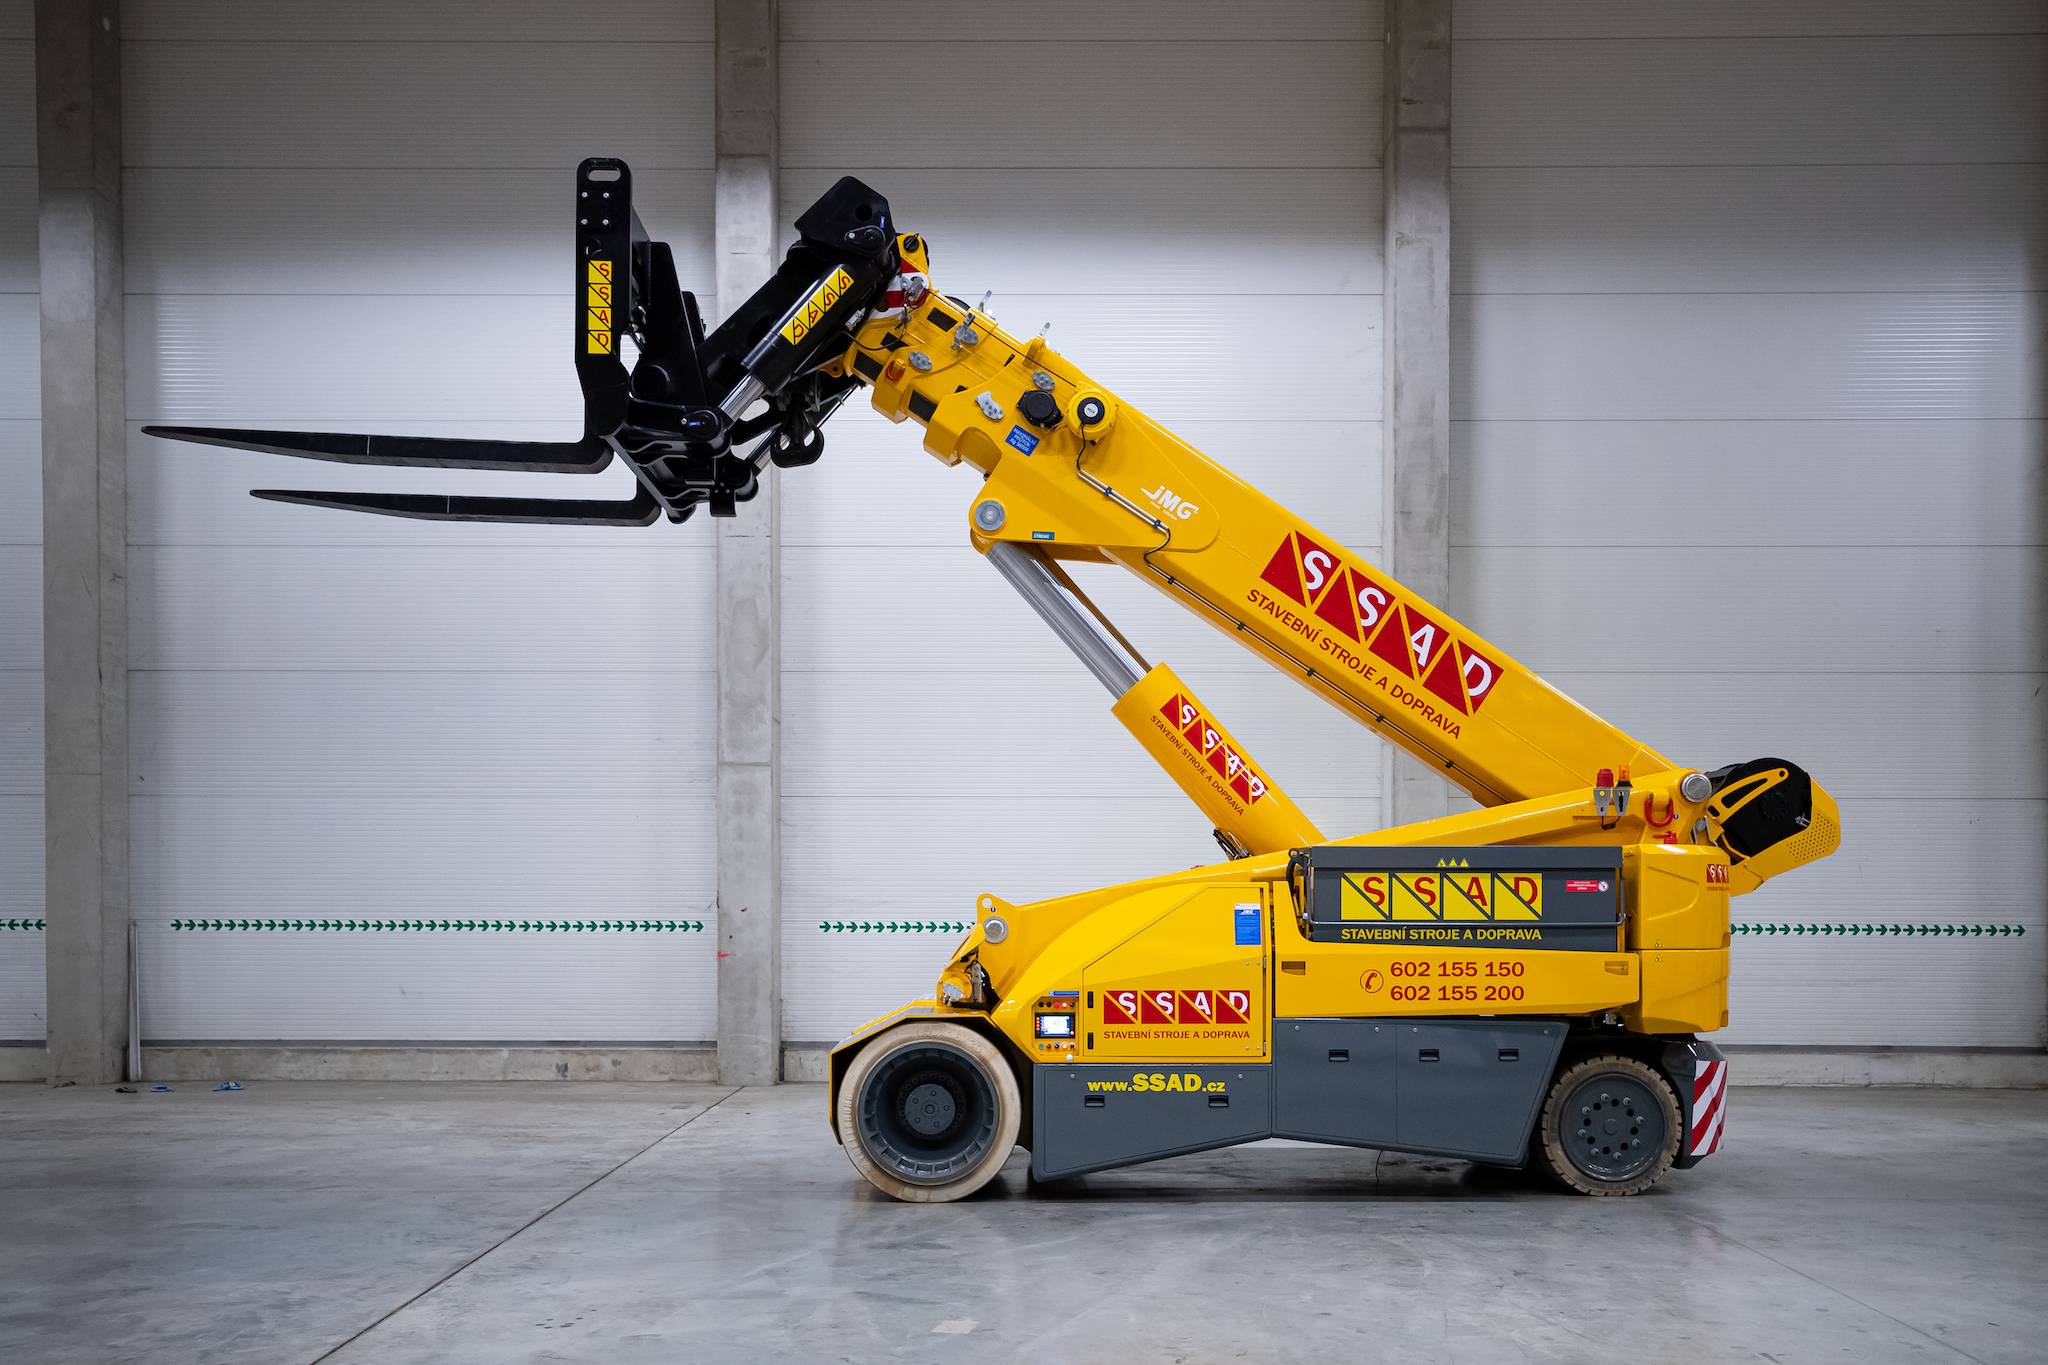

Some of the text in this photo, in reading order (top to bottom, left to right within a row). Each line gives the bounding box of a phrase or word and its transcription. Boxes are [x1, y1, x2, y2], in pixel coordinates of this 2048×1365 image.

[791, 273, 852, 340] SSAD
[1301, 548, 1494, 699] SSAD
[1246, 588, 1461, 740] STAVEBNÍ STROJE A DOPRAVA
[1179, 702, 1266, 798] SSAD
[1150, 715, 1245, 816] STAVEBNÍ STROJE A DOPRAVA
[1361, 875, 1540, 908] SSAD
[1341, 926, 1542, 940] STAVEBNÍ STROJE A DOPRAVA
[1390, 961, 1525, 977] 602 155 150
[1116, 990, 1250, 1018] SSAD
[1390, 985, 1525, 1001] 602 155 200
[1104, 1029, 1152, 1039] STAVEBNÍ
[1153, 1030, 1190, 1039] STROJE
[1203, 1030, 1250, 1039] DOPRAVA
[1087, 1073, 1226, 1092] www.SSAD.cz
